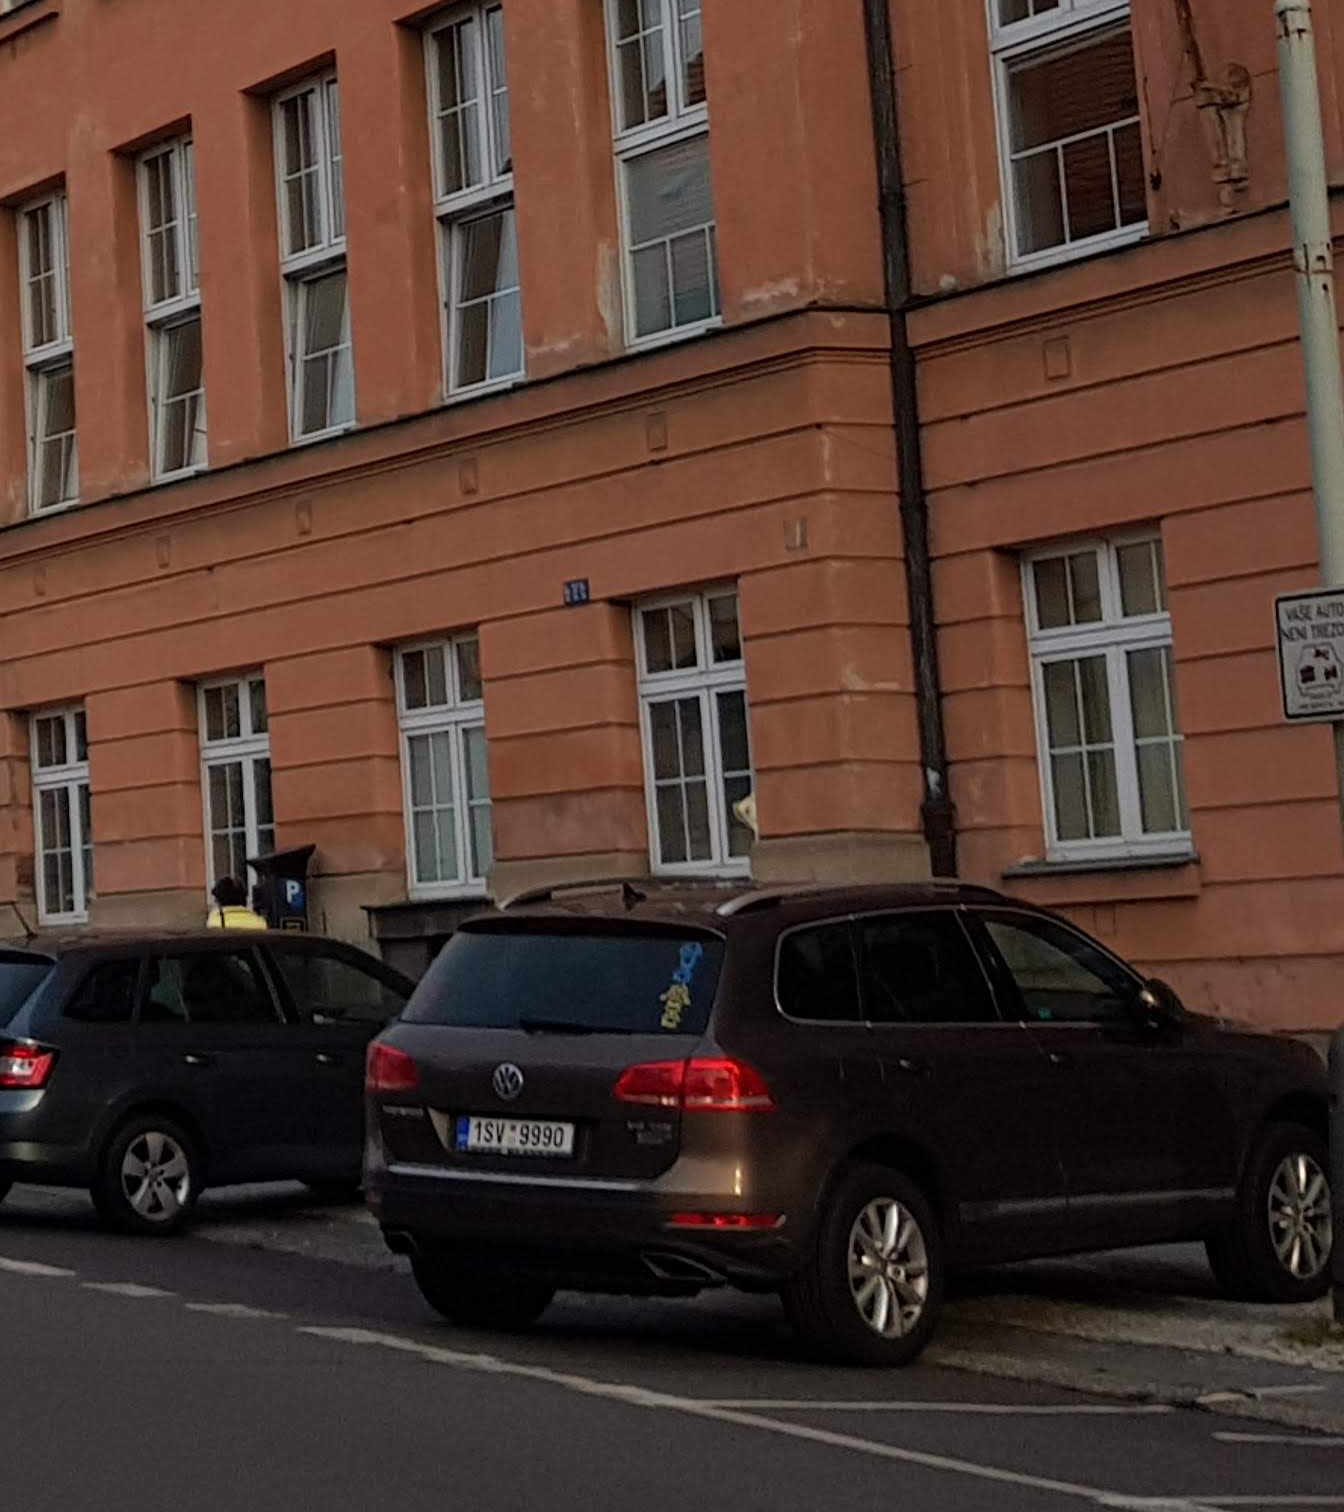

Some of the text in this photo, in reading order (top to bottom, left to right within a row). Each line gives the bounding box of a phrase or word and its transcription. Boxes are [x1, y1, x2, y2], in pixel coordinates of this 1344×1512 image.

[286, 879, 300, 904] P
[476, 1120, 564, 1147] 1SV 9990
